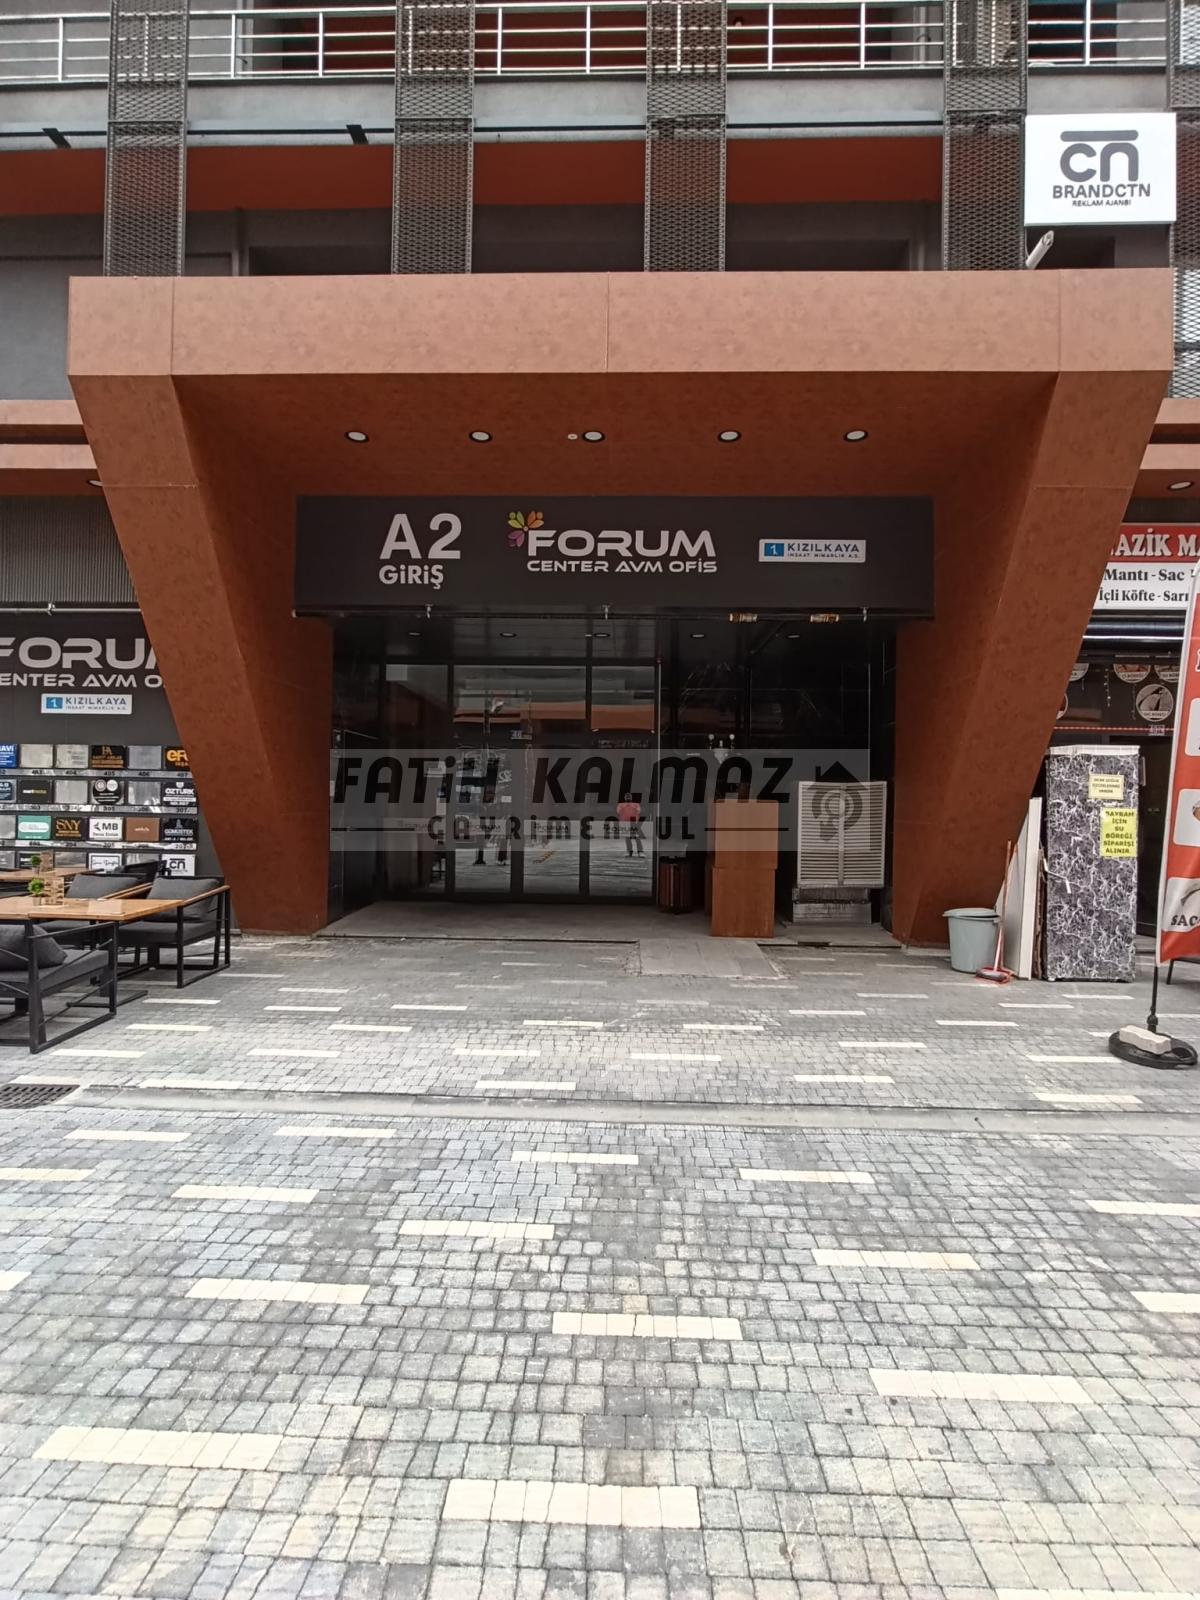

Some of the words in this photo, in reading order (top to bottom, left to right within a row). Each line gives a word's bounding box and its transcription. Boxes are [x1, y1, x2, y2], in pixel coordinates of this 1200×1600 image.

[1052, 183, 1151, 199] BRANDCTN
[1072, 199, 1104, 207] REKLAM
[379, 513, 462, 560] A2
[527, 529, 717, 558] FORUM
[1111, 528, 1172, 556] AZİK
[1177, 534, 1200, 556] M
[787, 543, 860, 552] KIZILKAYA
[527, 560, 609, 573] CENTER
[614, 560, 664, 573] AVM
[669, 558, 718, 573] OFİS
[1158, 569, 1185, 581] Sac
[1122, 589, 1155, 602] Köfte
[82, 674, 138, 688] AVM
[144, 675, 165, 688] O
[65, 696, 127, 705] KIZILKAYA
